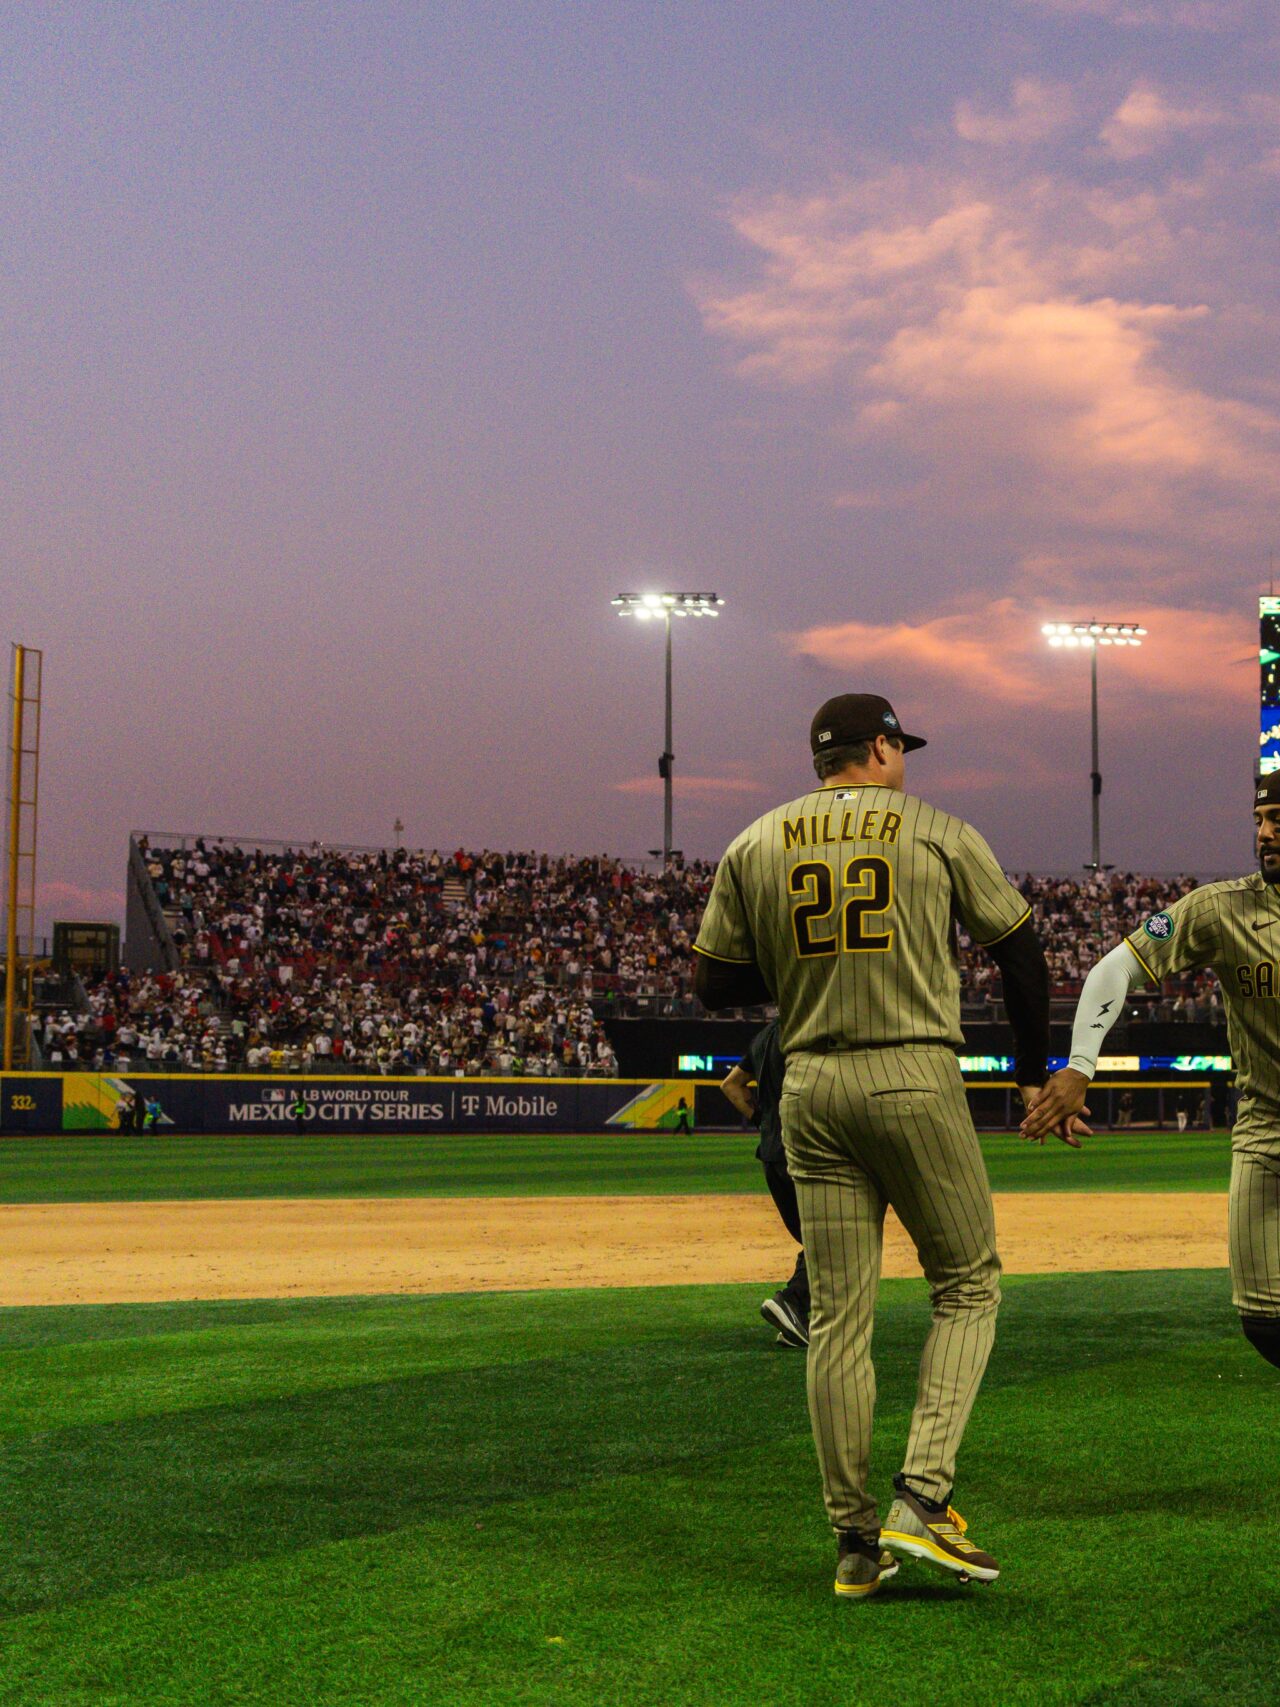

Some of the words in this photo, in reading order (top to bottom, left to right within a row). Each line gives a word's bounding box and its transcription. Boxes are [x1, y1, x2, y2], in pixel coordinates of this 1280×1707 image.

[783, 810, 902, 850] MILLER
[788, 854, 894, 958] 22
[290, 1090, 320, 1101] MLB
[321, 1090, 371, 1101] WORLD
[374, 1090, 409, 1101] TOUR
[229, 1104, 316, 1120] MEXICO
[318, 1104, 368, 1120] CITY
[370, 1104, 443, 1120] SERIES
[485, 1096, 558, 1116] Mobile
